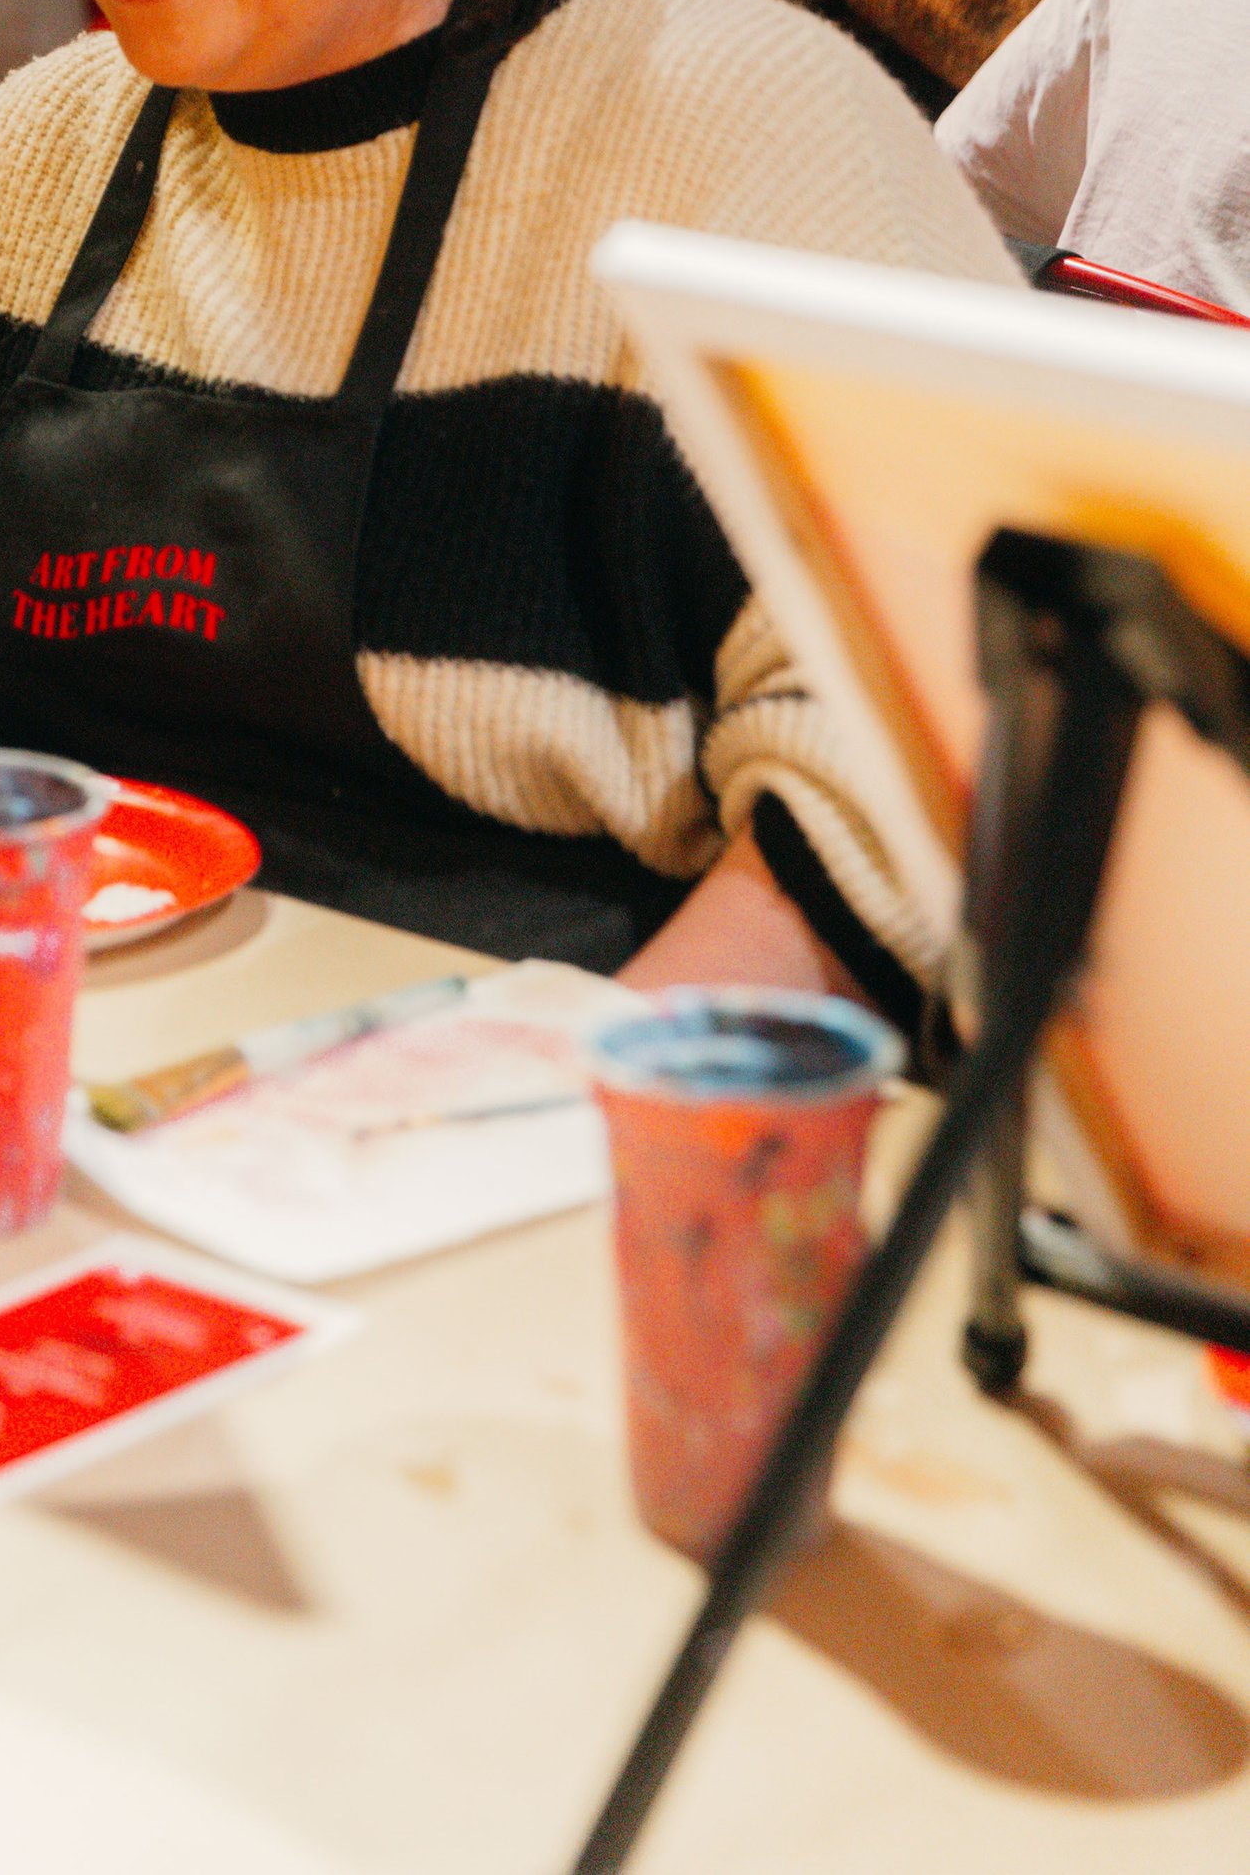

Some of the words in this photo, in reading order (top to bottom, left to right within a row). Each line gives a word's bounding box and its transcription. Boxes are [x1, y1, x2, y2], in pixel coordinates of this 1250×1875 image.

[29, 551, 99, 590] ART
[100, 544, 217, 588] FROM
[13, 588, 79, 640] THE
[84, 589, 227, 642] HEART
